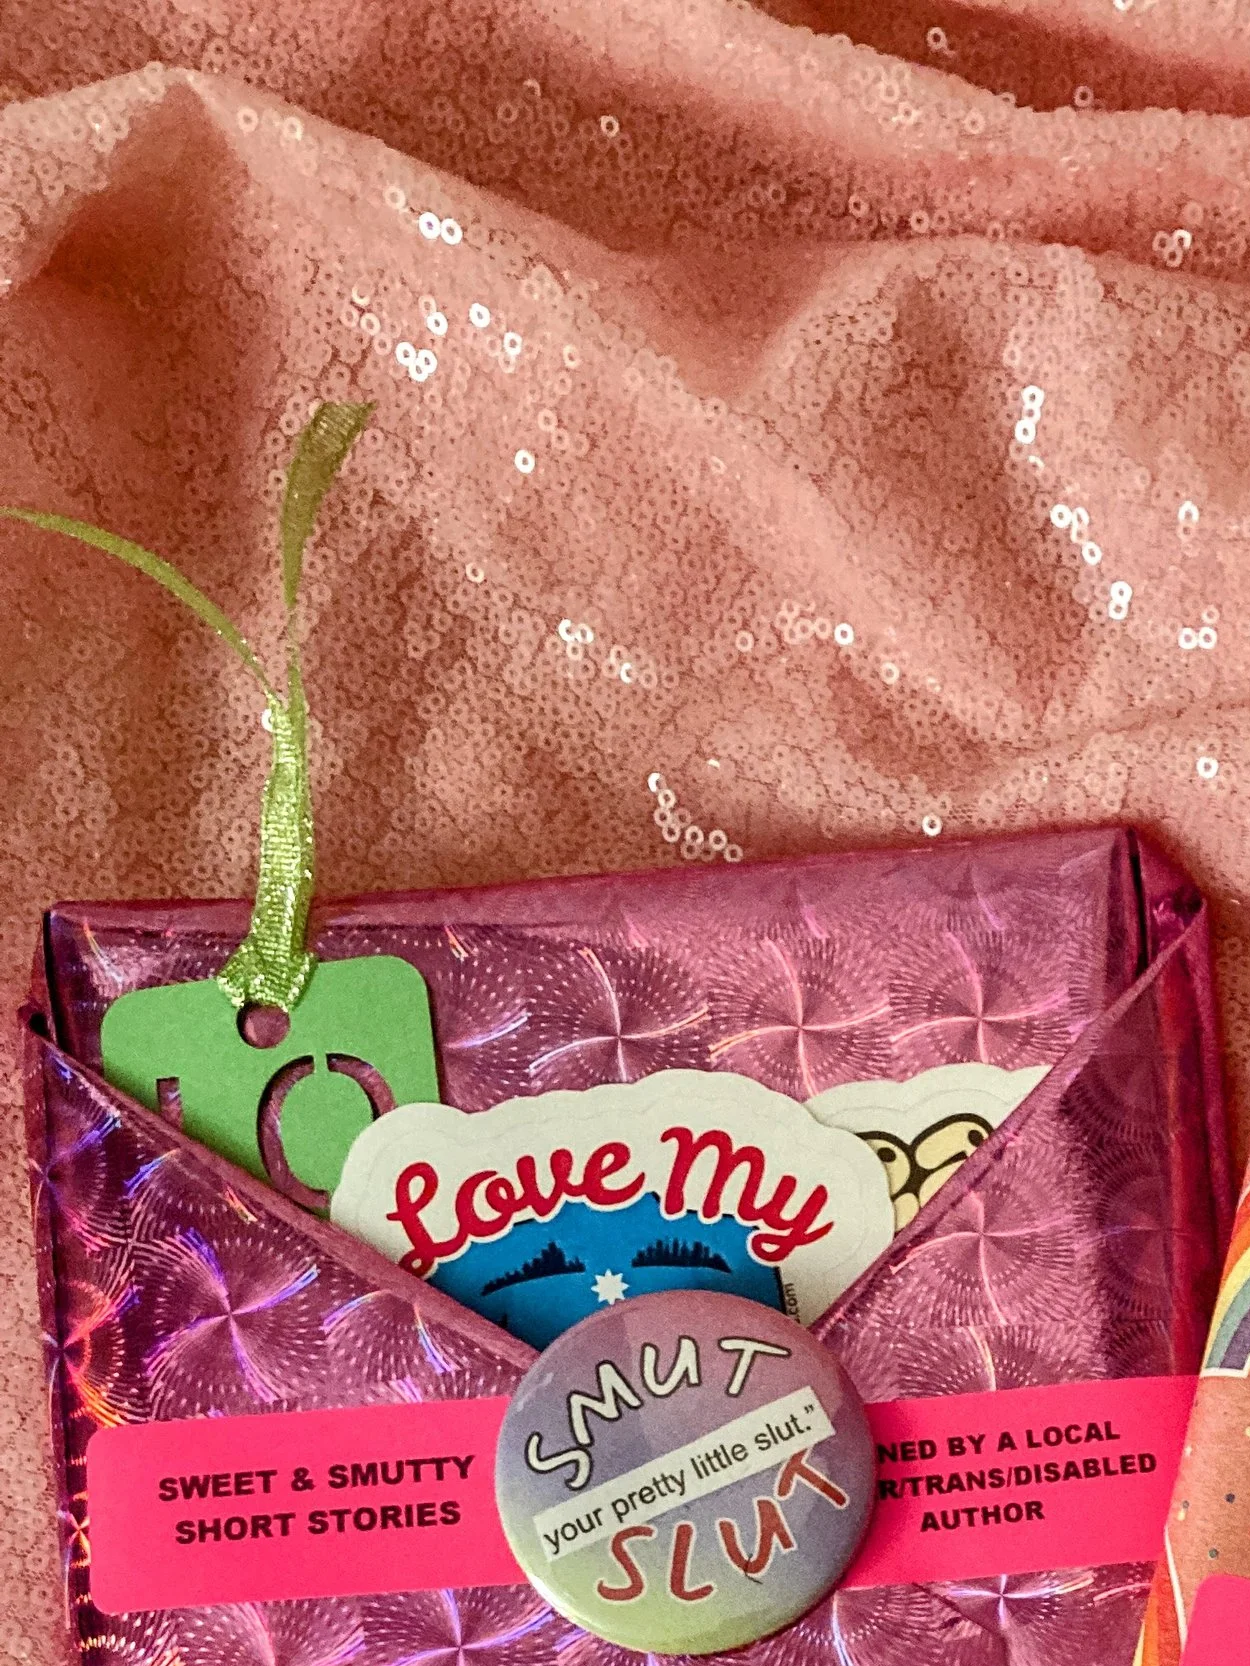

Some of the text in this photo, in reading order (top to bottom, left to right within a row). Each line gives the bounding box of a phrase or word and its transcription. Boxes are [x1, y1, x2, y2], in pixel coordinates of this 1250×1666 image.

[386, 1142, 646, 1278] Love
[660, 1126, 834, 1262] My
[525, 1335, 792, 1491] SMUT
[876, 1421, 1120, 1465] NED BY A LOCAL
[158, 1455, 474, 1502] SWEET & SMUTTY
[543, 1507, 603, 1555] your
[611, 1469, 685, 1524] pretty
[691, 1443, 749, 1481] little
[878, 1453, 1158, 1501] R/TRANS/DISABLED
[175, 1500, 461, 1545] SHORT STORIES
[596, 1449, 849, 1603] SLUT
[921, 1500, 1045, 1532] AUTHOR
